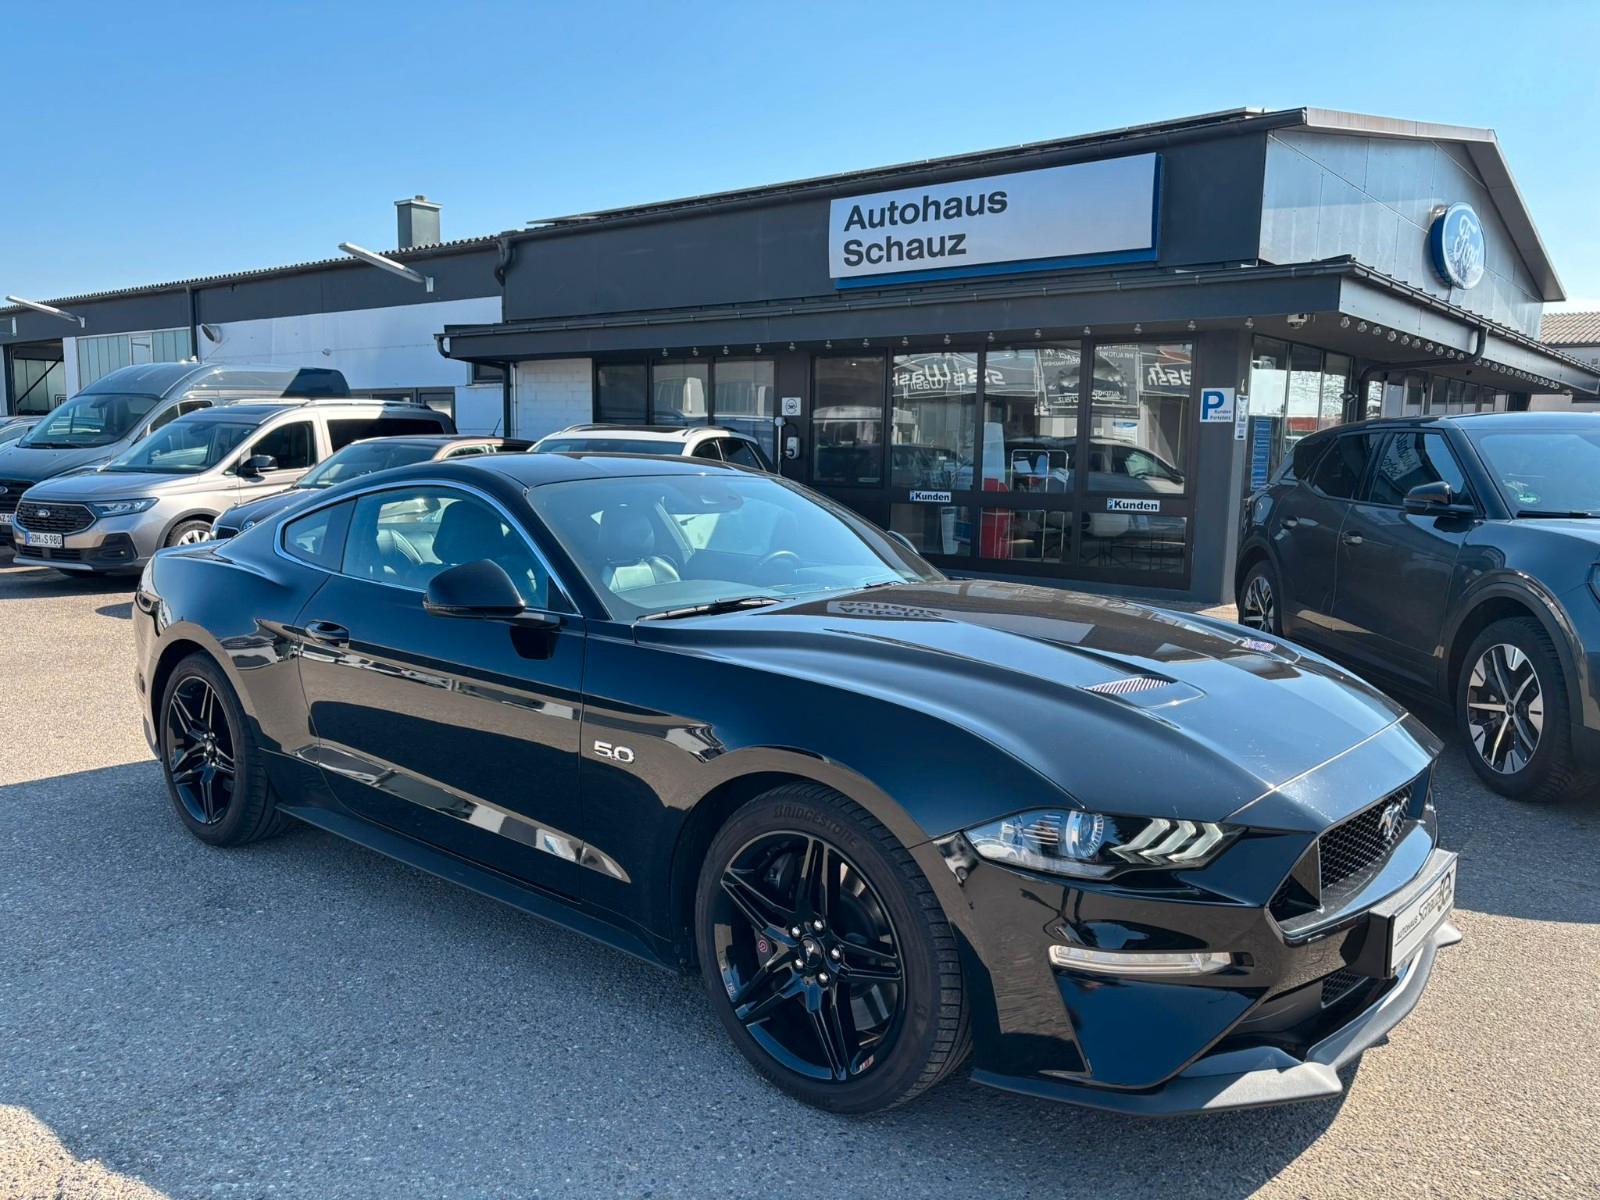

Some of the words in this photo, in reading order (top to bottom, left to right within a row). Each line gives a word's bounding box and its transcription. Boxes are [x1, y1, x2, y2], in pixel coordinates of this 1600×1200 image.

[843, 190, 1008, 232] Autohaus
[843, 233, 967, 267] Schauz
[1201, 391, 1225, 420] P
[915, 492, 950, 501] Kunden
[1114, 500, 1158, 510] Kunden
[593, 740, 635, 764] 5.0
[774, 804, 858, 848] BRIDGESTONE
